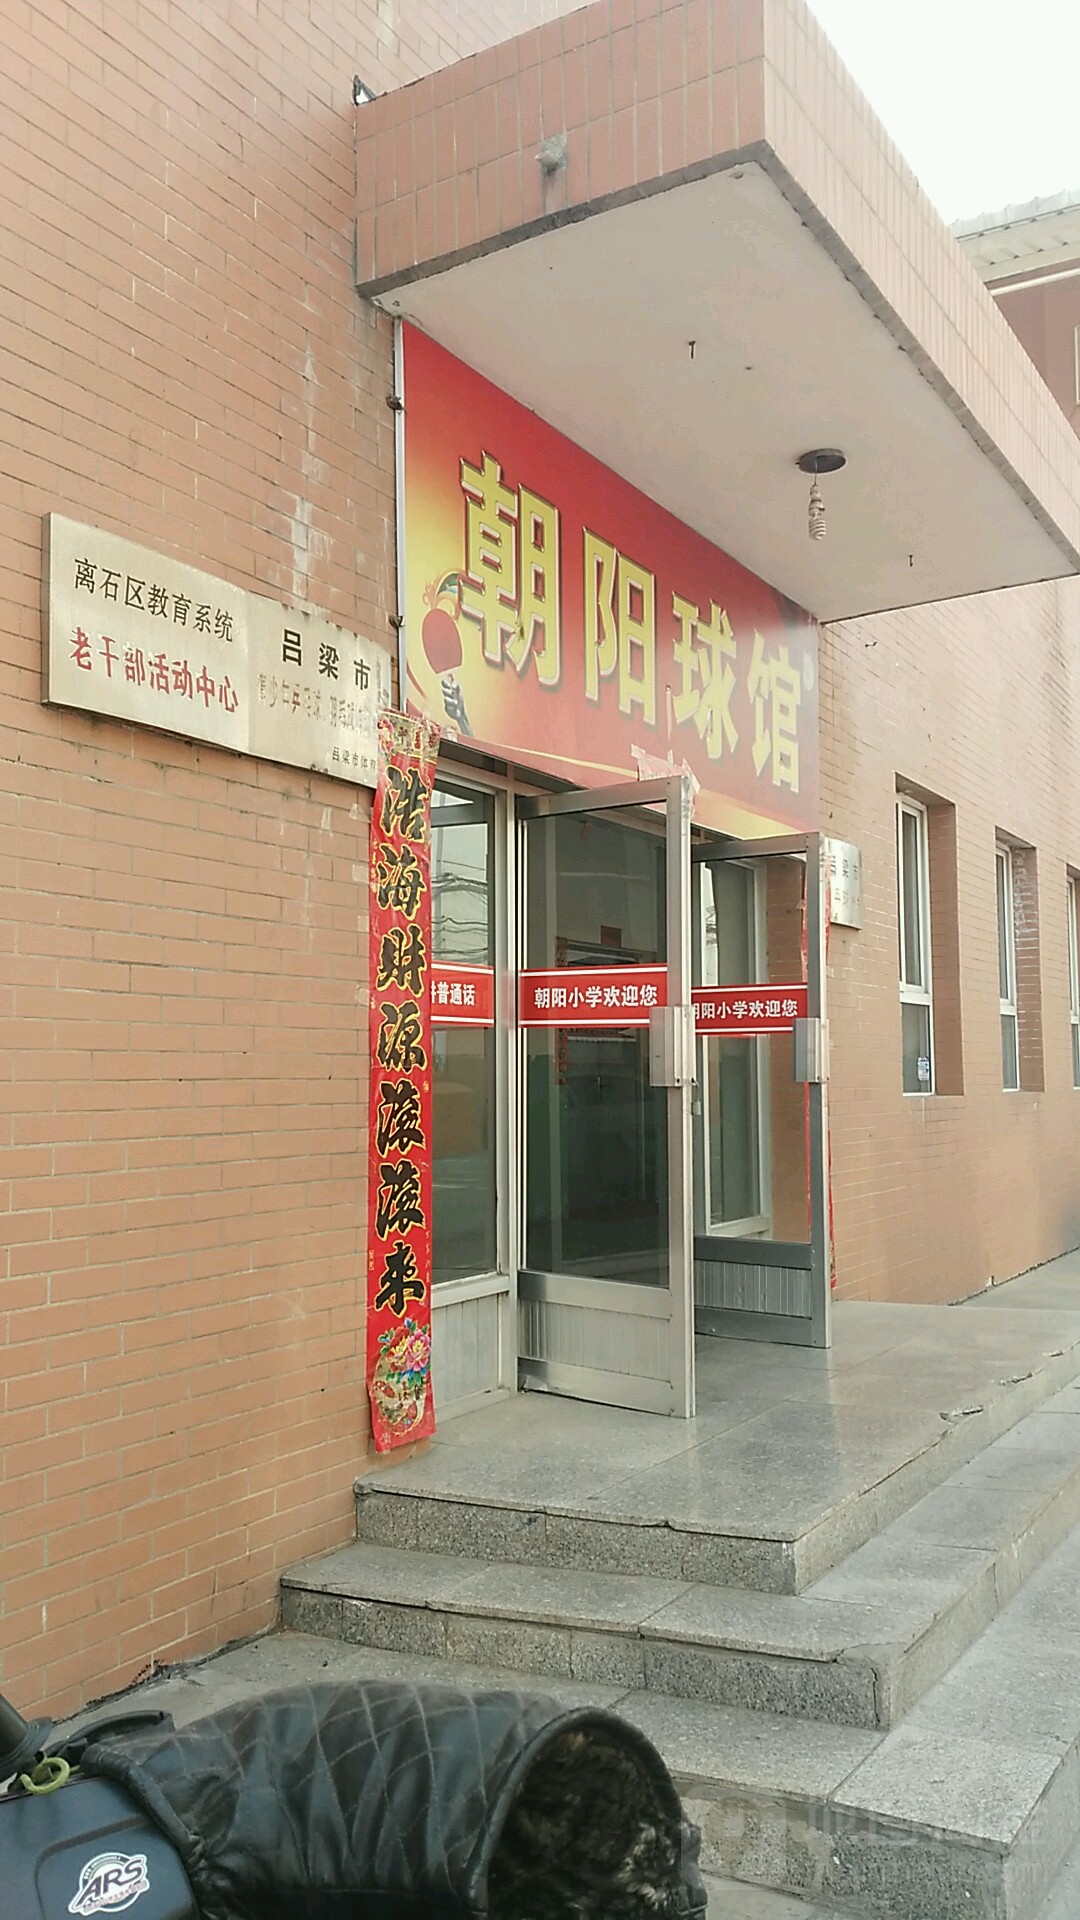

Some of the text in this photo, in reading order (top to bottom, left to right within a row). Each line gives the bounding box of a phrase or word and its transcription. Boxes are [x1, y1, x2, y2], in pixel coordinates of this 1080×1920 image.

[74, 557, 234, 643] 离石区教育系统
[459, 449, 801, 794] 朝阳球馆
[69, 626, 239, 714] 老干部活动中心
[282, 628, 371, 691] 吕梁市
[533, 984, 658, 1009] 朝阳小学欢迎您
[73, 1857, 143, 1908] ARS
